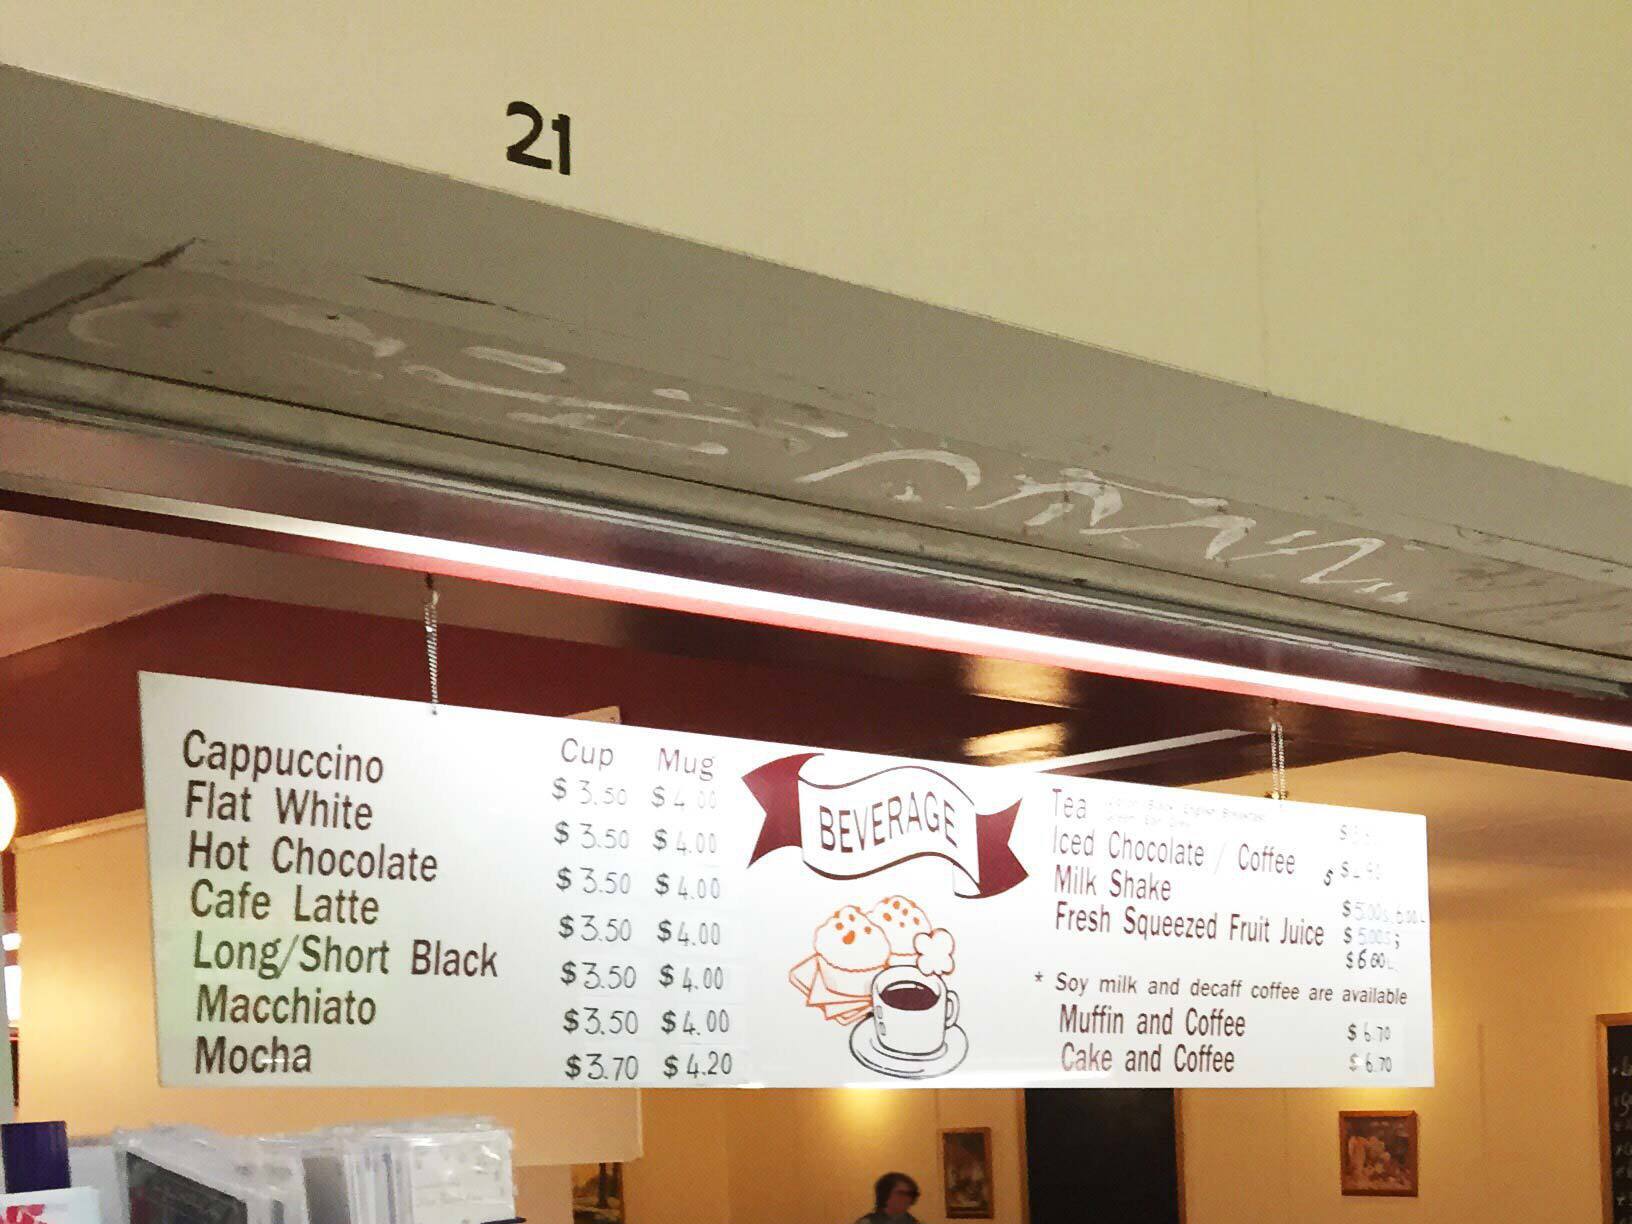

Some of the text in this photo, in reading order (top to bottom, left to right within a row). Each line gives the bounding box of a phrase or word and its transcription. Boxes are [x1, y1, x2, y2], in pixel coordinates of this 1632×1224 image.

[506, 101, 570, 175] 21
[182, 729, 385, 786] Cappuccino
[560, 737, 717, 782] Cup Mug
[184, 780, 374, 831] Flat White
[819, 788, 960, 855] BEVERAGE
[1051, 787, 1089, 821] Tea
[187, 830, 439, 883] Hot Chocolate
[1052, 827, 1095, 858] Iced
[1107, 830, 1206, 868] Chocolate
[1237, 841, 1297, 876] Coffee
[190, 878, 380, 926] Cafe Latte
[1053, 866, 1173, 901] Milk Shake
[1055, 901, 1112, 935] Fresh
[1123, 906, 1218, 942] Squeezed
[1228, 912, 1272, 944] Fruit
[1279, 914, 1326, 947] Juice
[192, 929, 499, 981] Long/Short Black
[196, 985, 378, 1027] Macchiato
[1054, 972, 1408, 1007] Soy milk and decaff coffee are available
[1057, 1004, 1247, 1038] Muffin and Coffee
[194, 1036, 313, 1075] Mocha
[1060, 1040, 1236, 1075] Cake and Coffee
